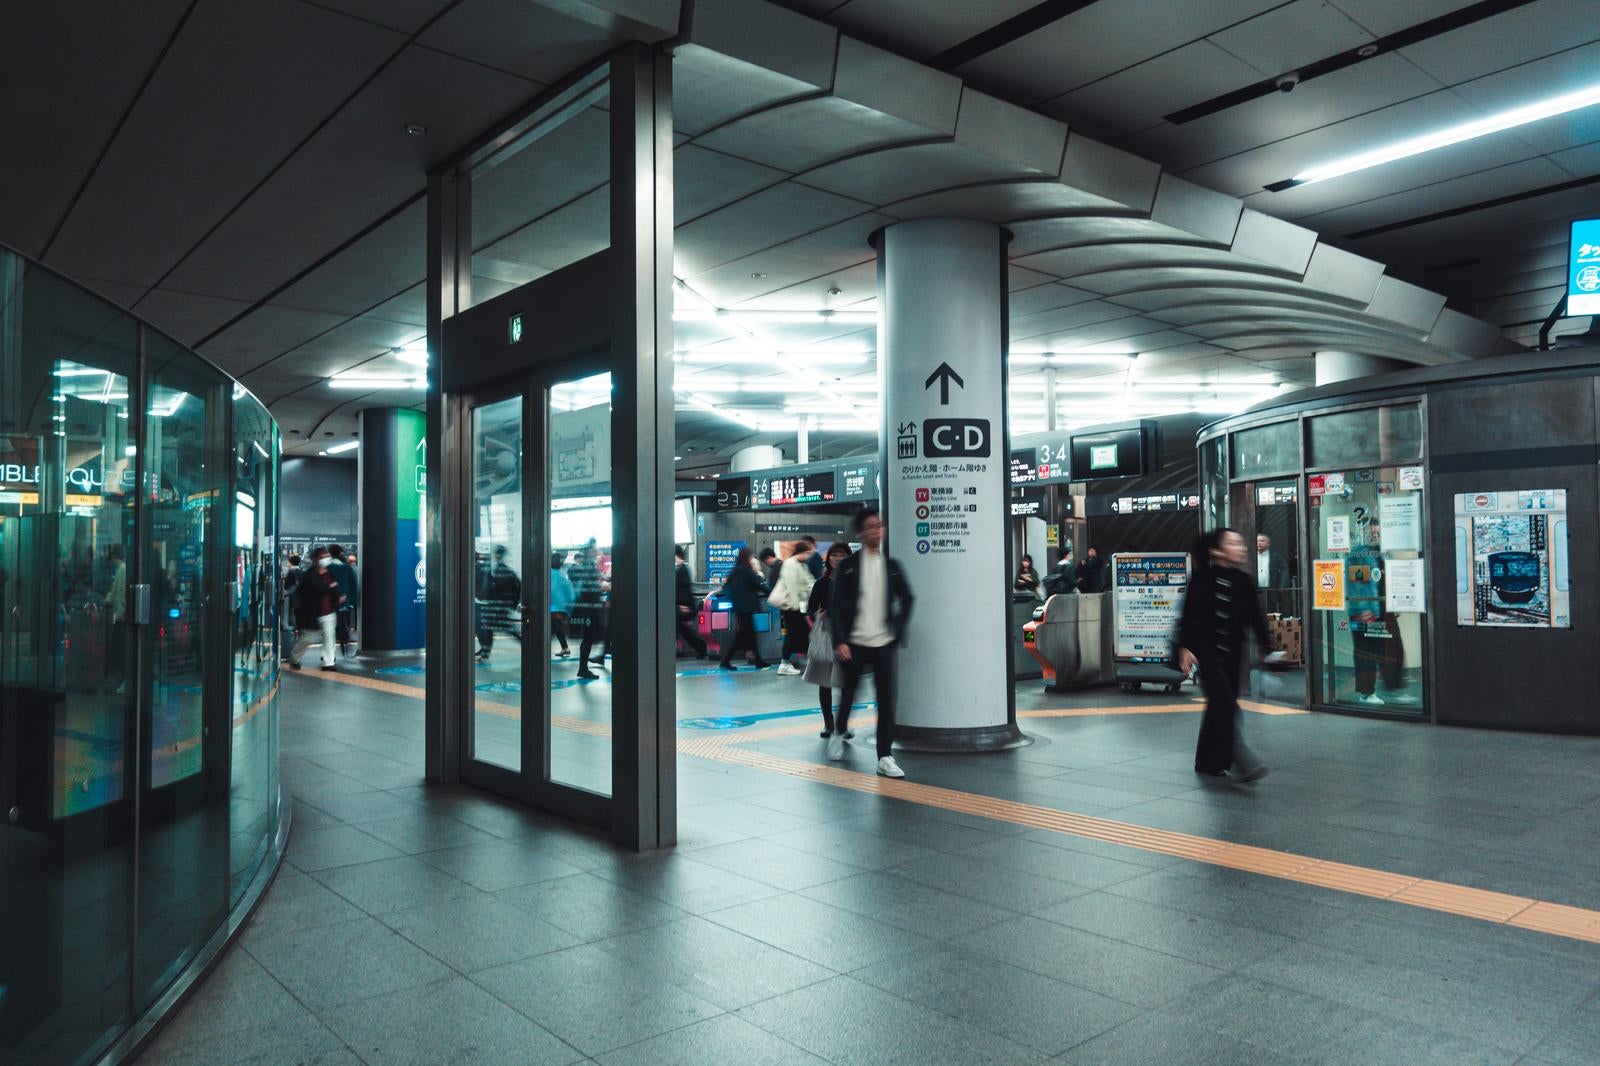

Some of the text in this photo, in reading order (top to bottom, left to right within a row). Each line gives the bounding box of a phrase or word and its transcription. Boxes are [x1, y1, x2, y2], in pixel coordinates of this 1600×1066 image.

[917, 491, 927, 499] TY
[931, 487, 953, 495] 東横線
